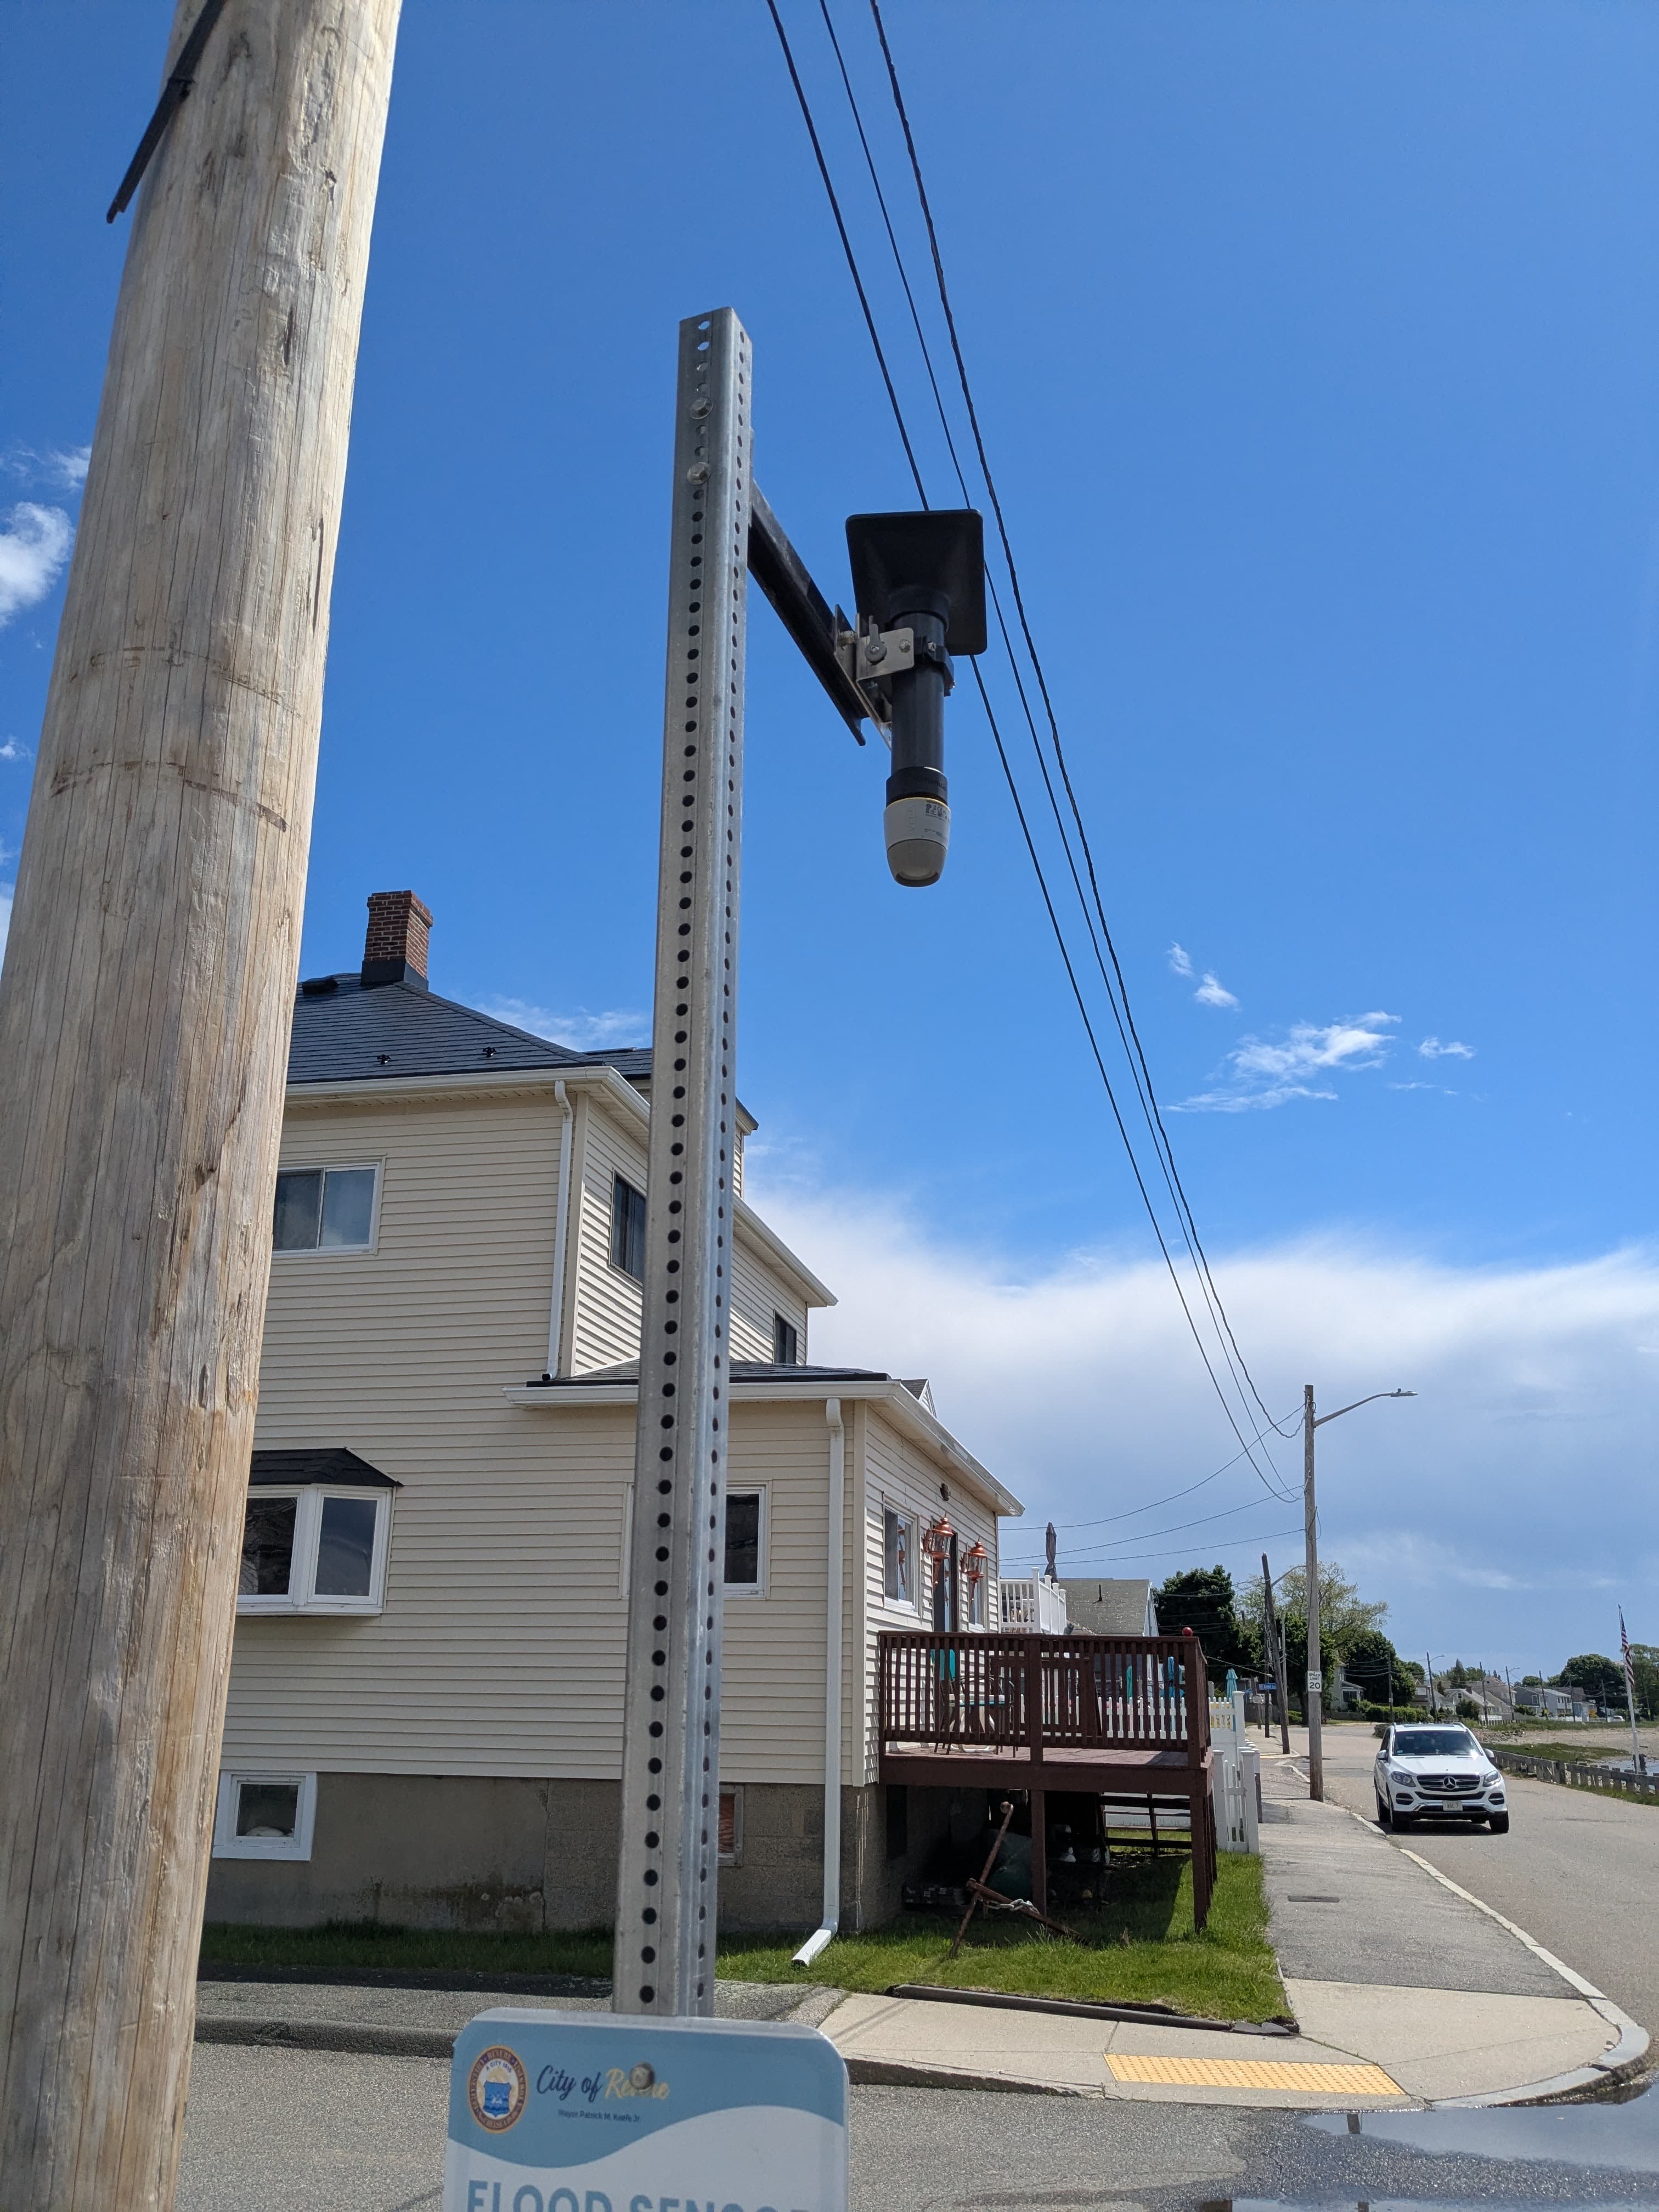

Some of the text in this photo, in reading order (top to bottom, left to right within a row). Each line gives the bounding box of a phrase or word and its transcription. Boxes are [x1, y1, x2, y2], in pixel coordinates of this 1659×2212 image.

[537, 2065, 575, 2101] City
[581, 2072, 602, 2103] of
[579, 2110, 602, 2120] Patrick
